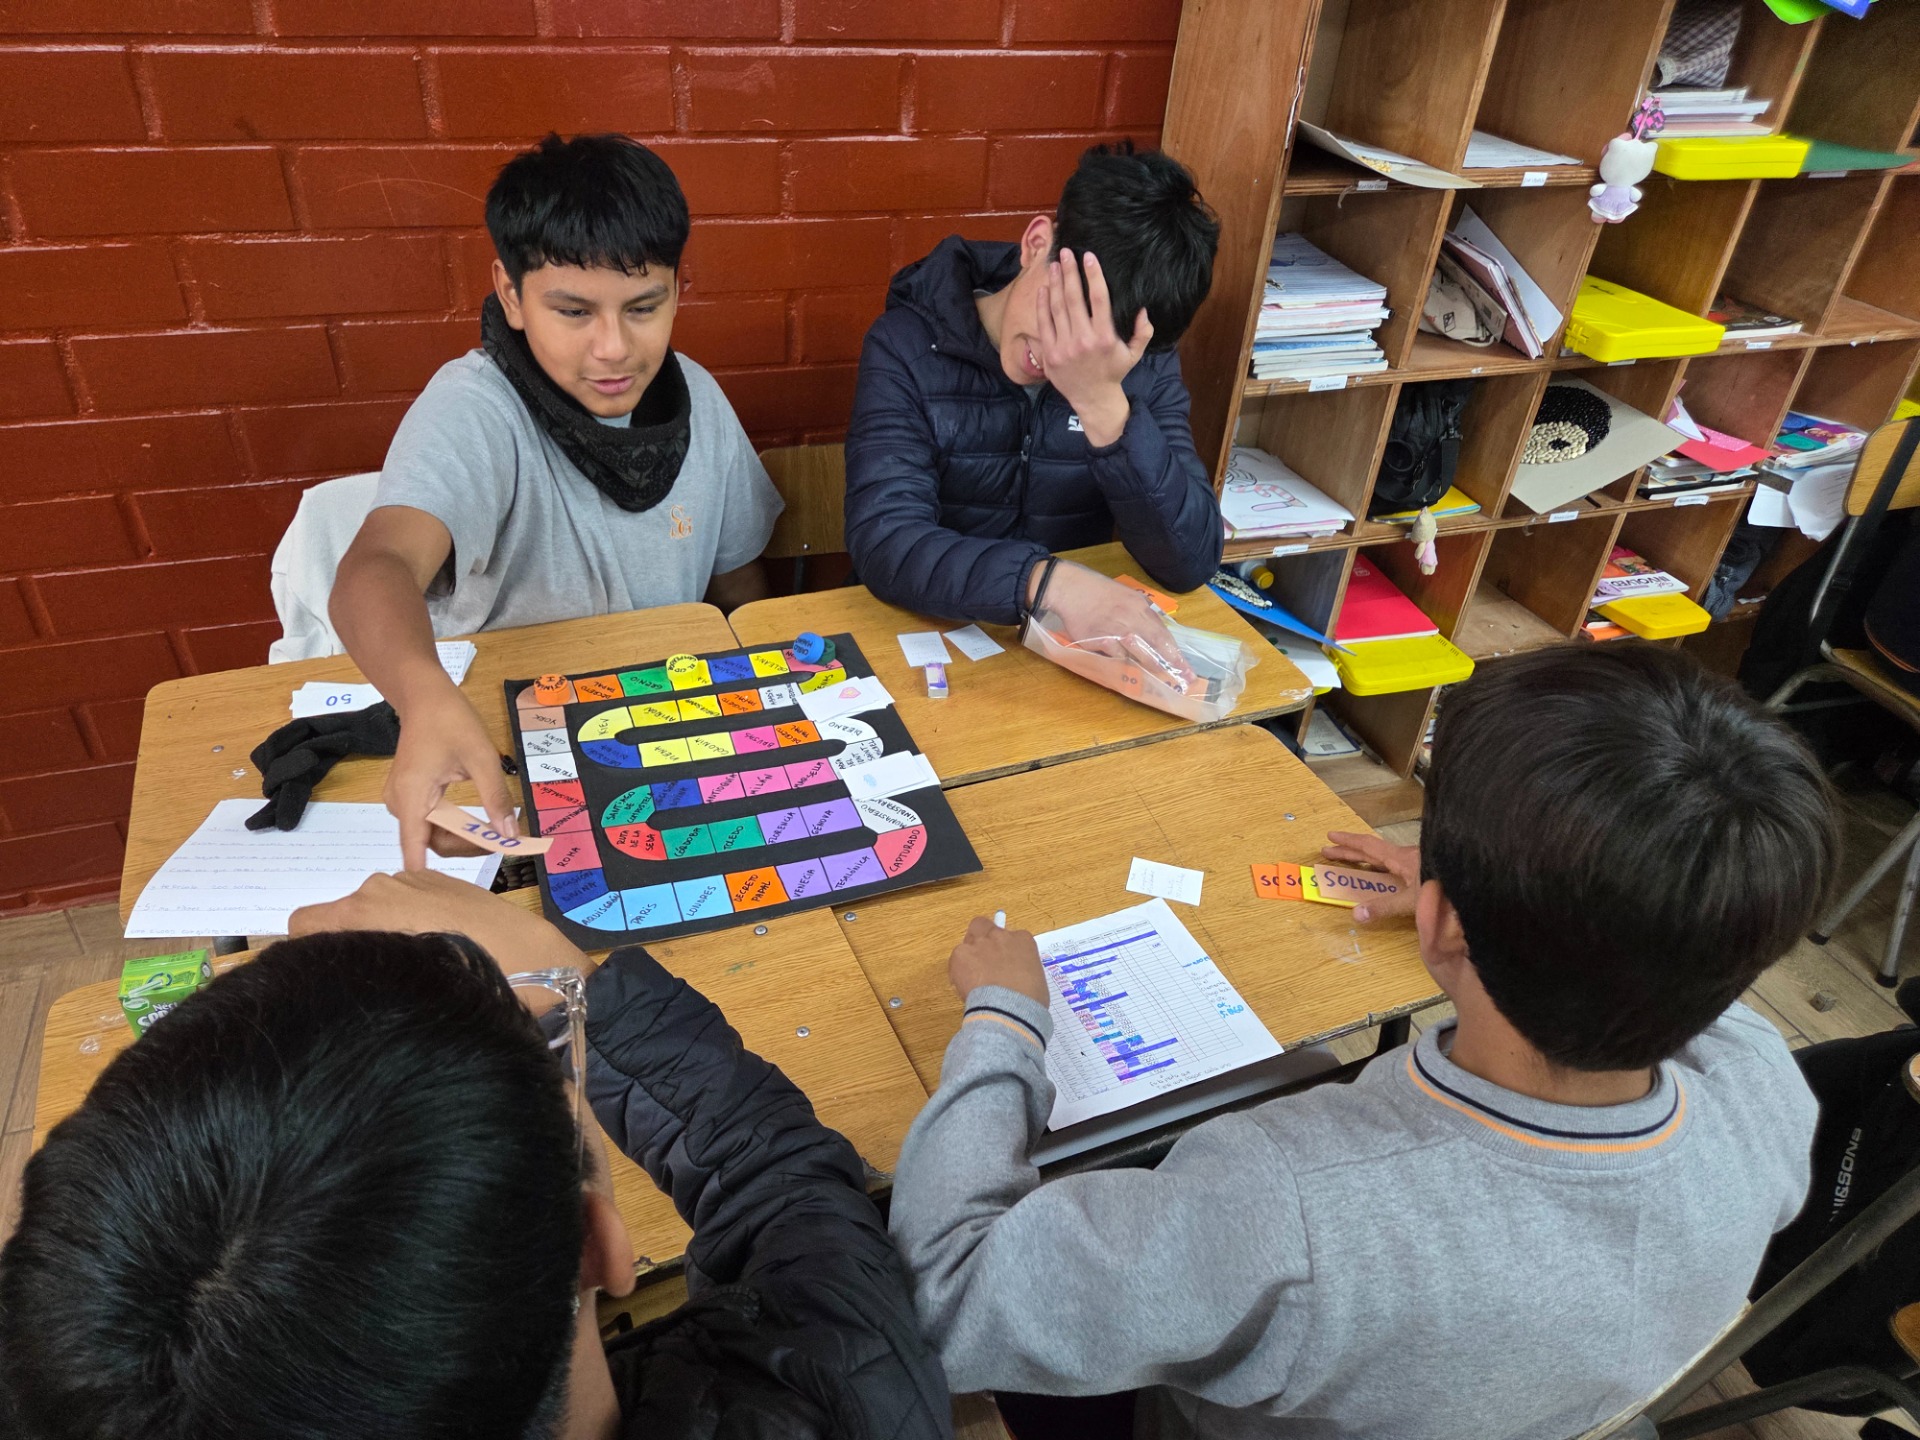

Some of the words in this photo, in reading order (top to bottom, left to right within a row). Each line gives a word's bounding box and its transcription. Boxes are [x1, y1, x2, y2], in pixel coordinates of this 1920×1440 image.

[325, 693, 352, 707] 50
[532, 714, 557, 726] YORK
[598, 718, 610, 736] KIEV
[544, 733, 567, 745] CLUNY
[540, 762, 573, 778] TRIBUTO
[462, 822, 521, 847] 100
[616, 829, 630, 845] RUTA
[723, 825, 744, 850] TOLEDO
[767, 811, 796, 844] FLORENCIA
[645, 833, 655, 851] SEDA
[889, 829, 921, 873] CAPTURADO
[556, 846, 581, 868] ROMA
[734, 874, 759, 903] DECRETO
[751, 880, 772, 902] PAPAL
[793, 869, 816, 897] VENECIA
[1323, 870, 1398, 894] SOLDADO
[686, 885, 717, 917] LONDRES
